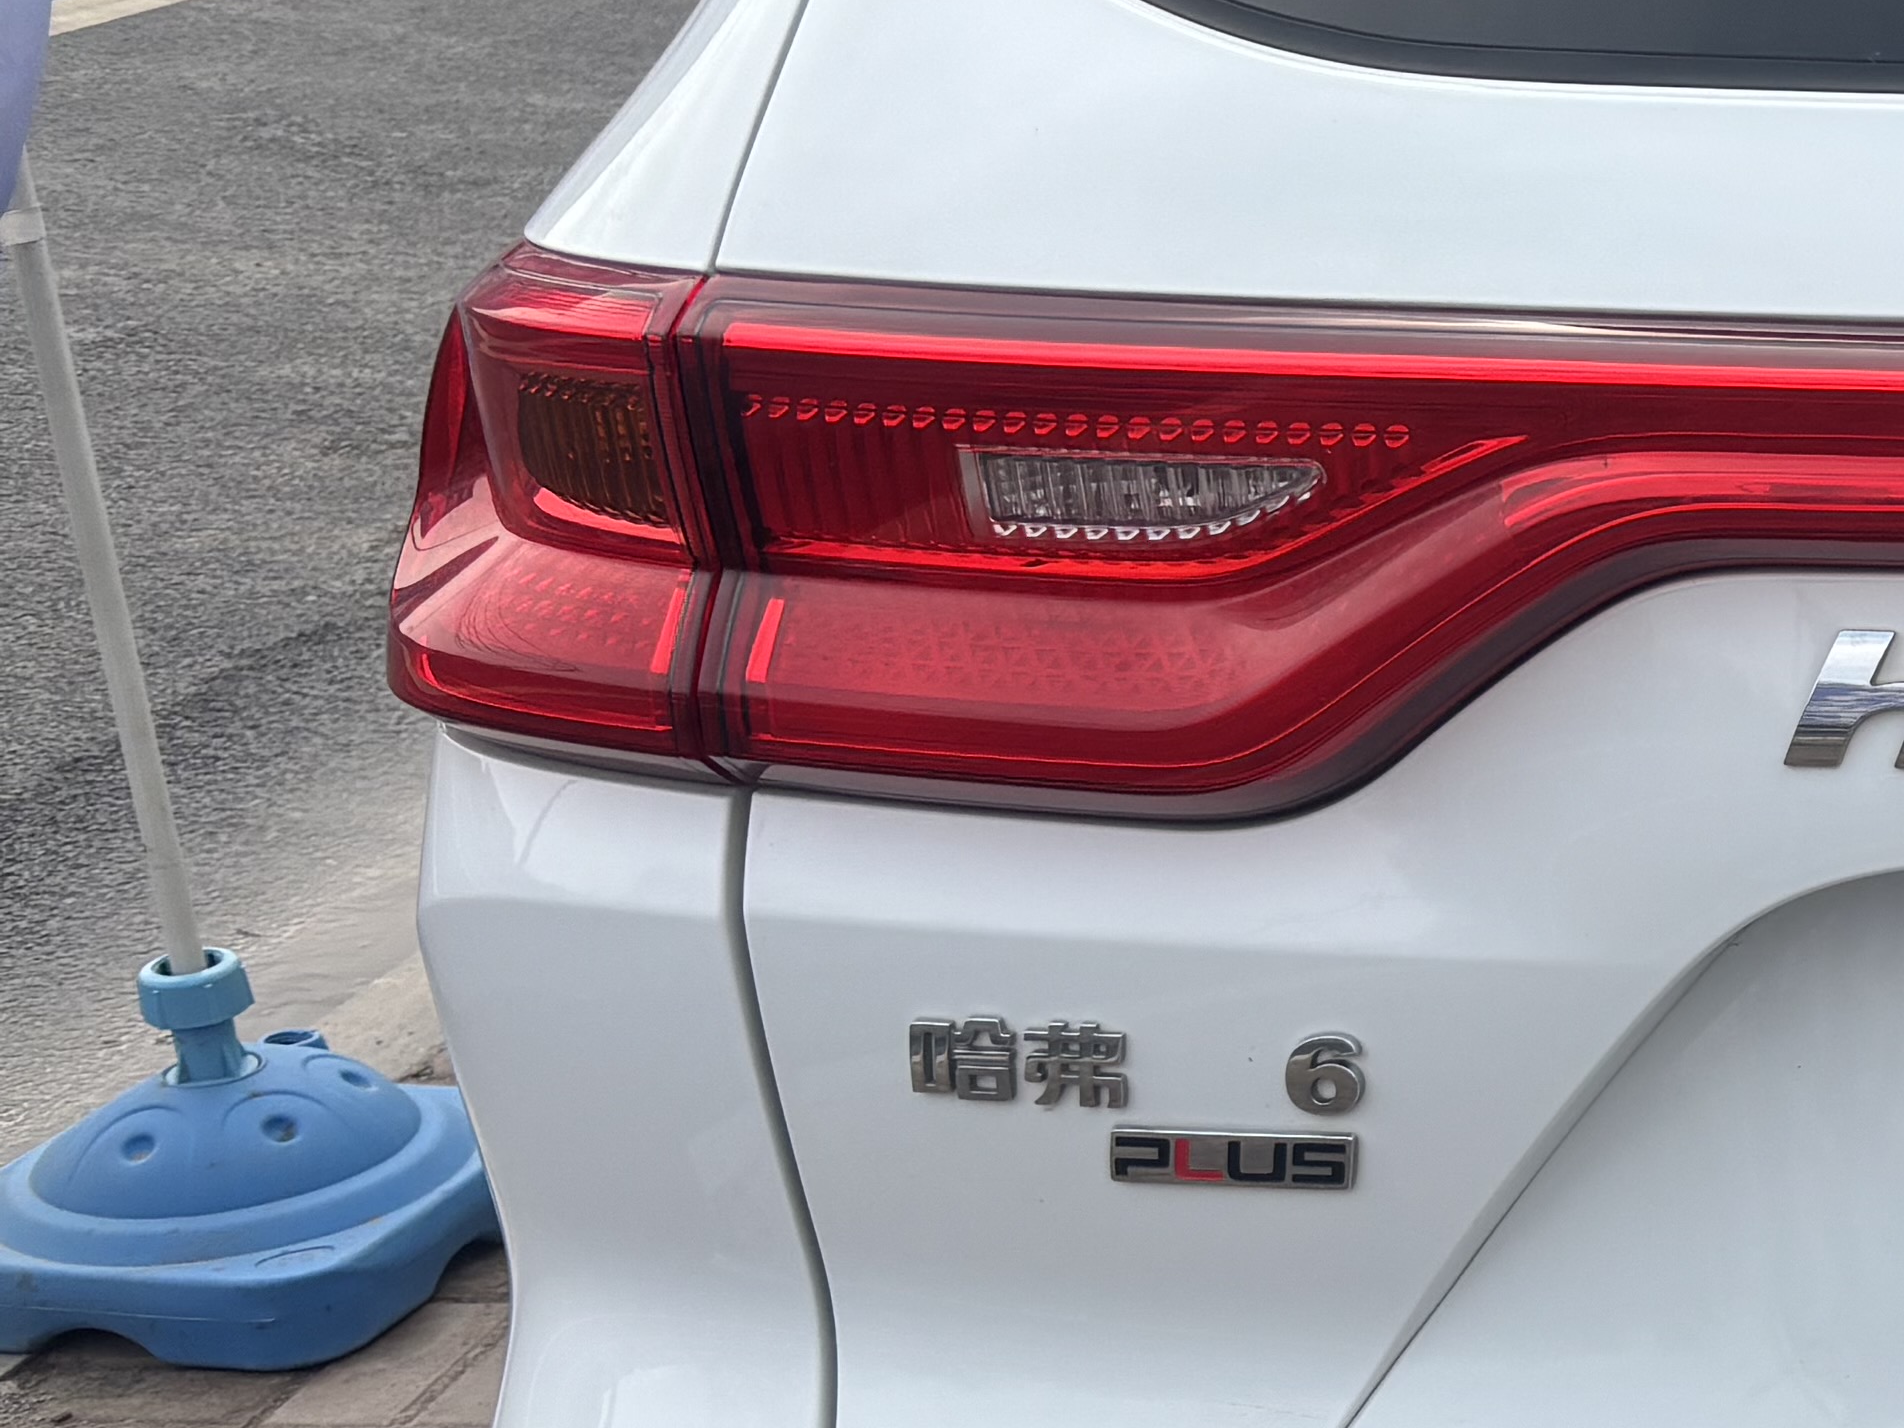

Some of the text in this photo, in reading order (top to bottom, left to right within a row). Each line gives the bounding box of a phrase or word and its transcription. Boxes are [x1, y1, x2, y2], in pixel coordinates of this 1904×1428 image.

[909, 1016, 1366, 1116] 哈弗 6
[1113, 1135, 1348, 1185] PLUS
